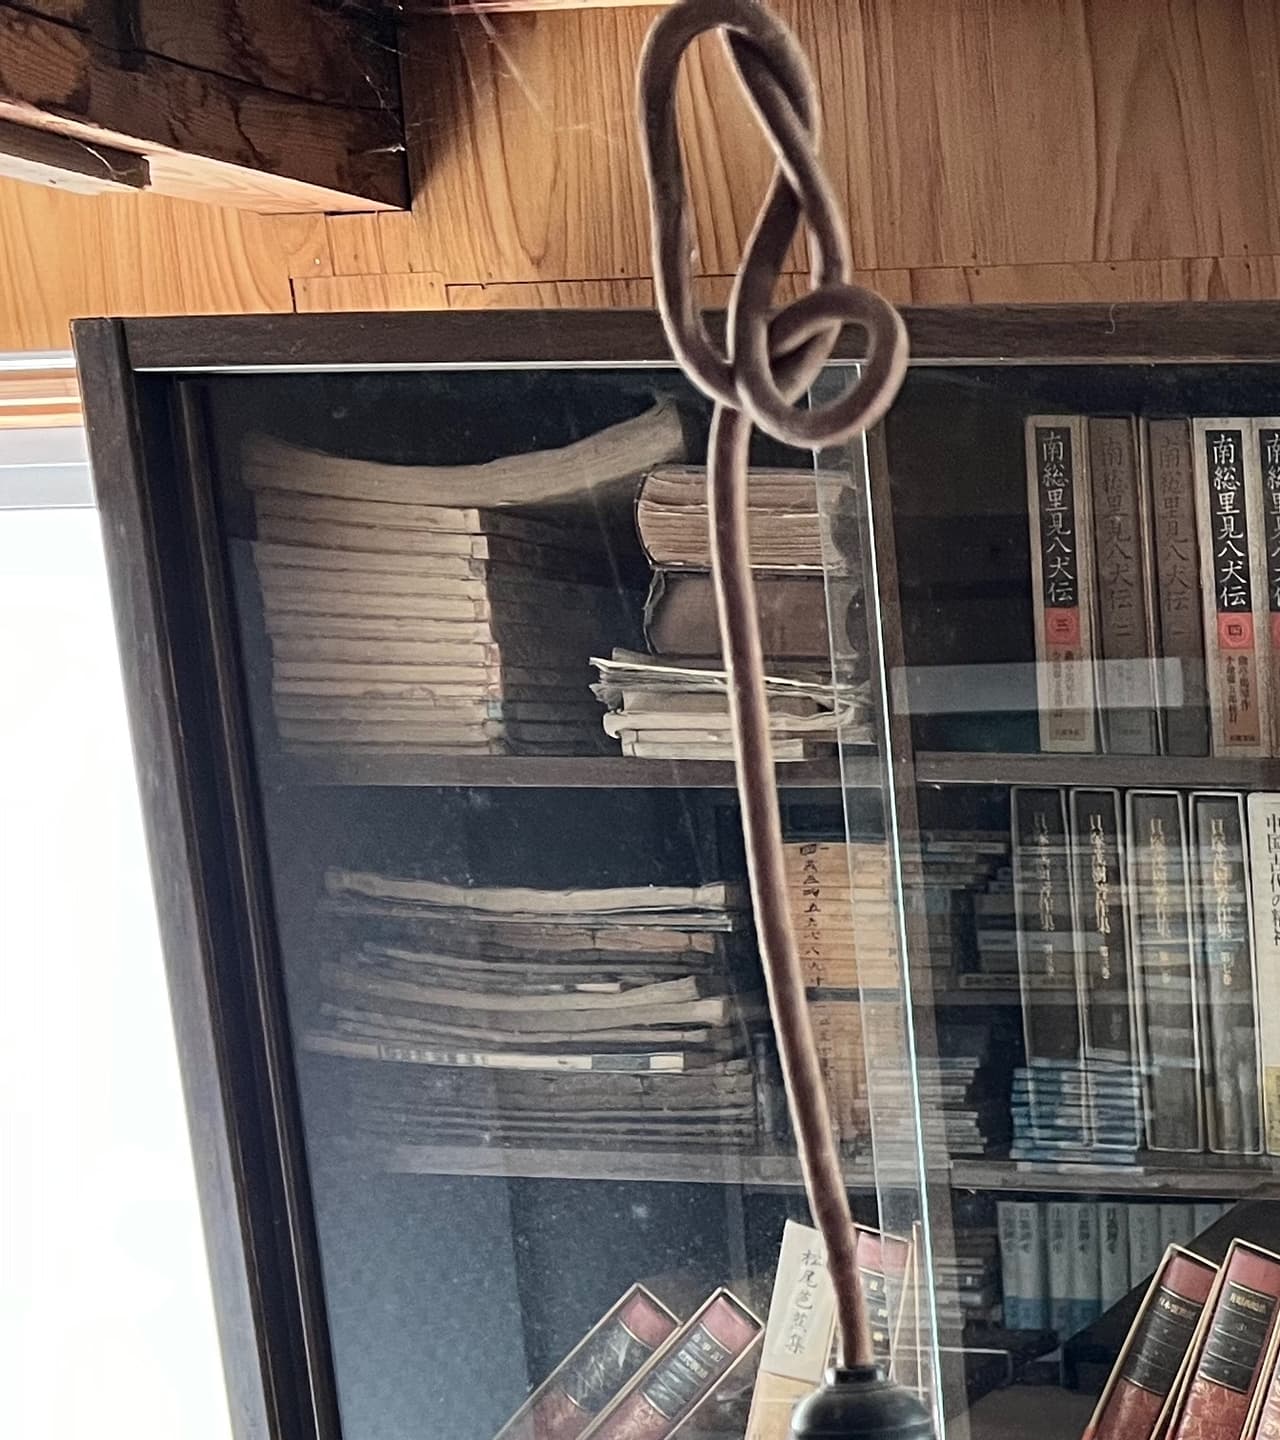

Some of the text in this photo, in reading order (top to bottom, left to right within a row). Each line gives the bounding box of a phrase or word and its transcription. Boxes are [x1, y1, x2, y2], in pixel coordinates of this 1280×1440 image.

[1042, 432, 1074, 603] 南総里見八犬伝
[1212, 433, 1248, 608] 南総里見八犬伝
